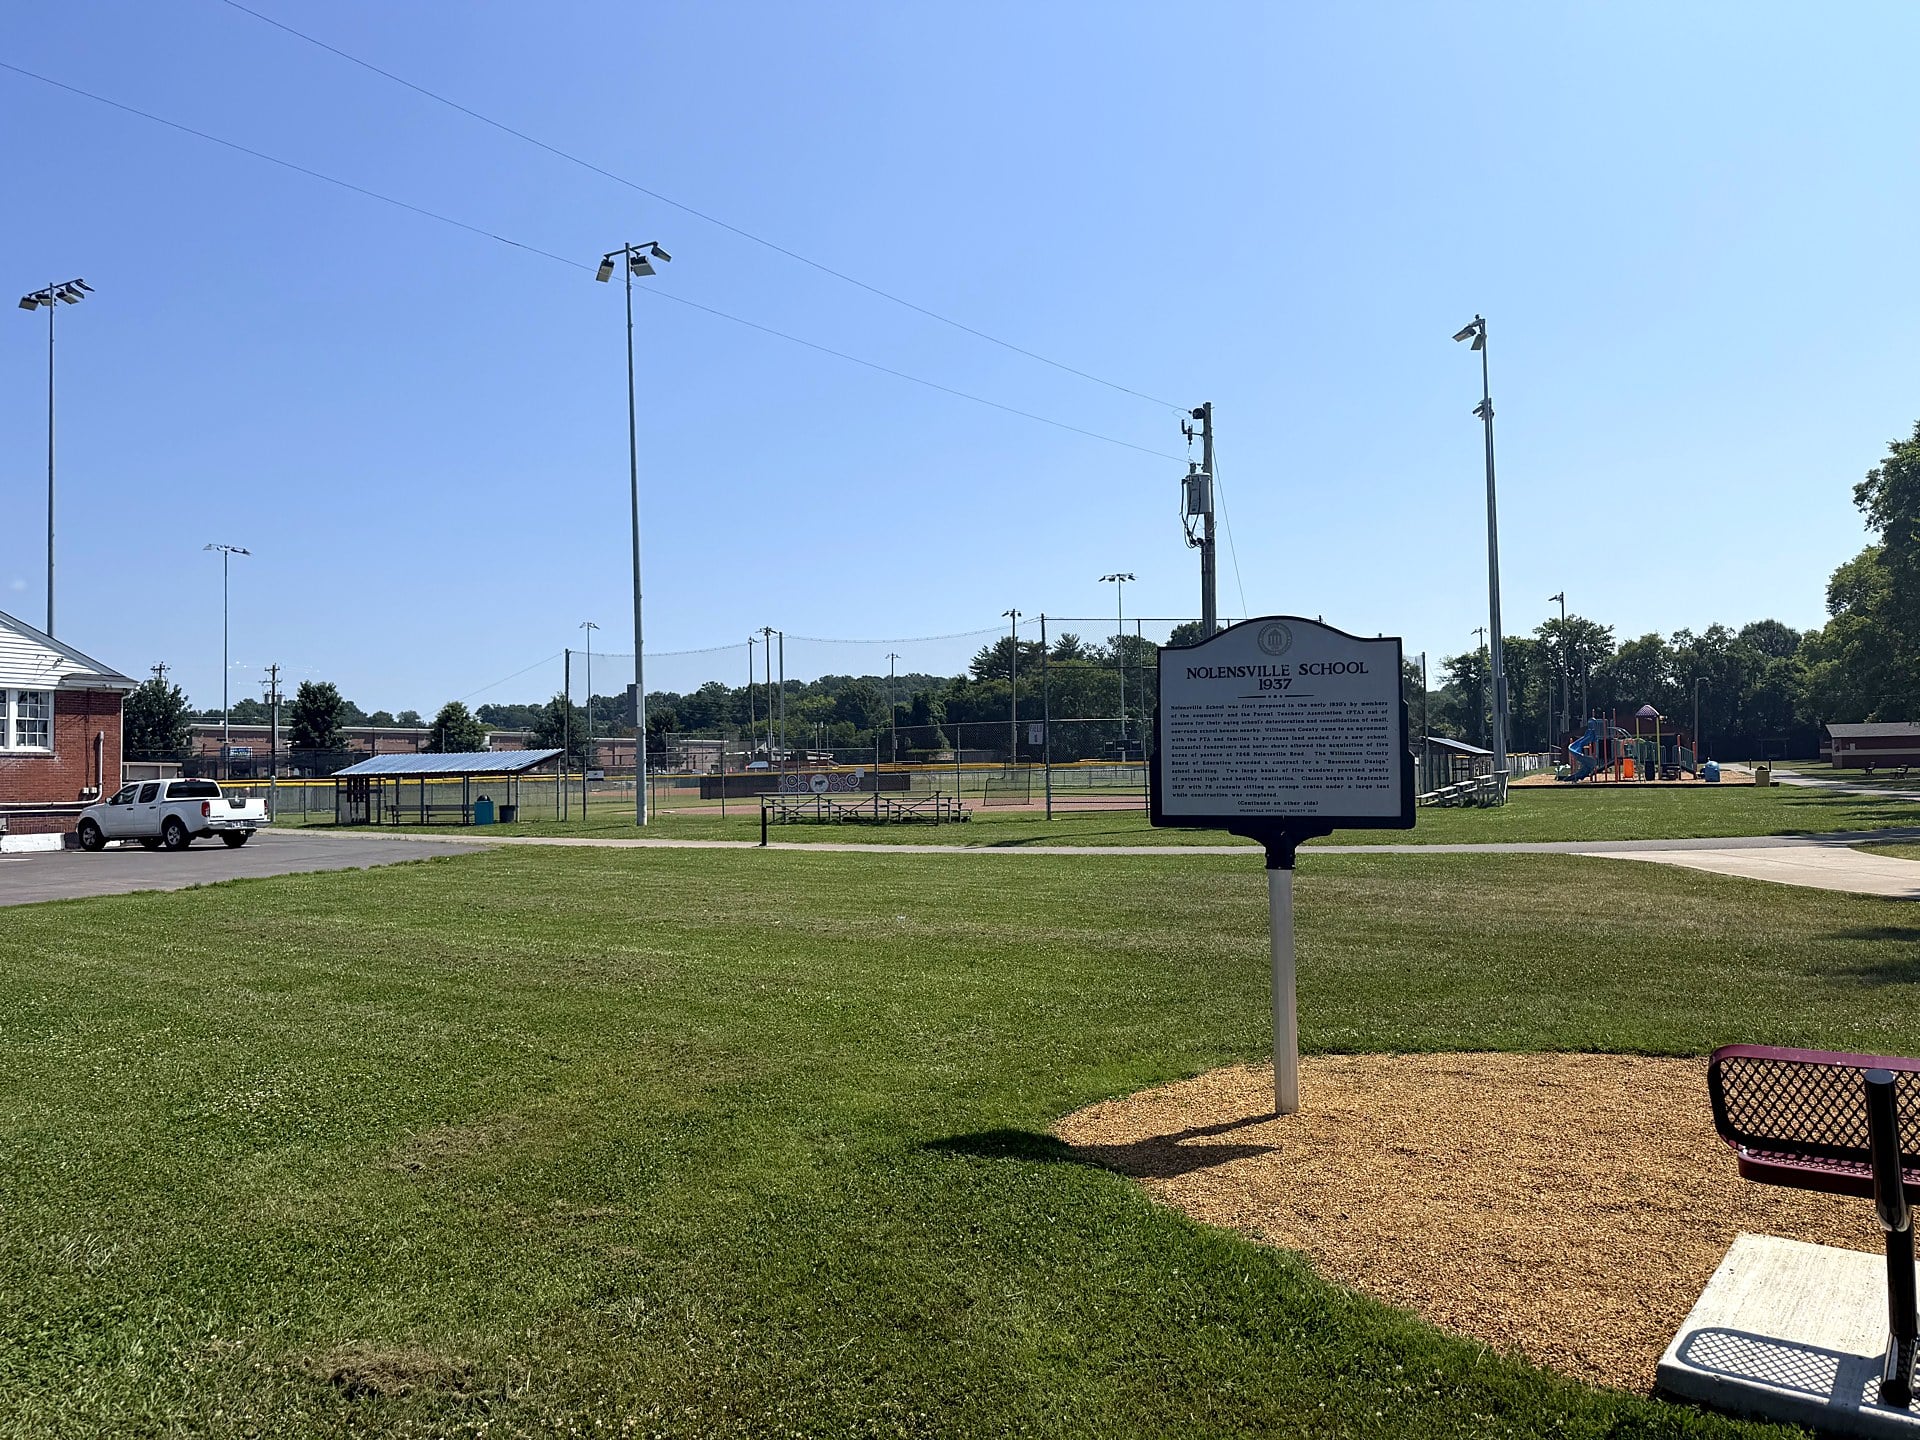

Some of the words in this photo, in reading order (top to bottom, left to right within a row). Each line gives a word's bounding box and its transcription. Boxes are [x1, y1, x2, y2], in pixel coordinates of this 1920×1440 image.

[1186, 664, 1291, 680] NOLENSVILLE
[1298, 661, 1369, 676] SCHOOL
[1258, 678, 1293, 691] 1937
